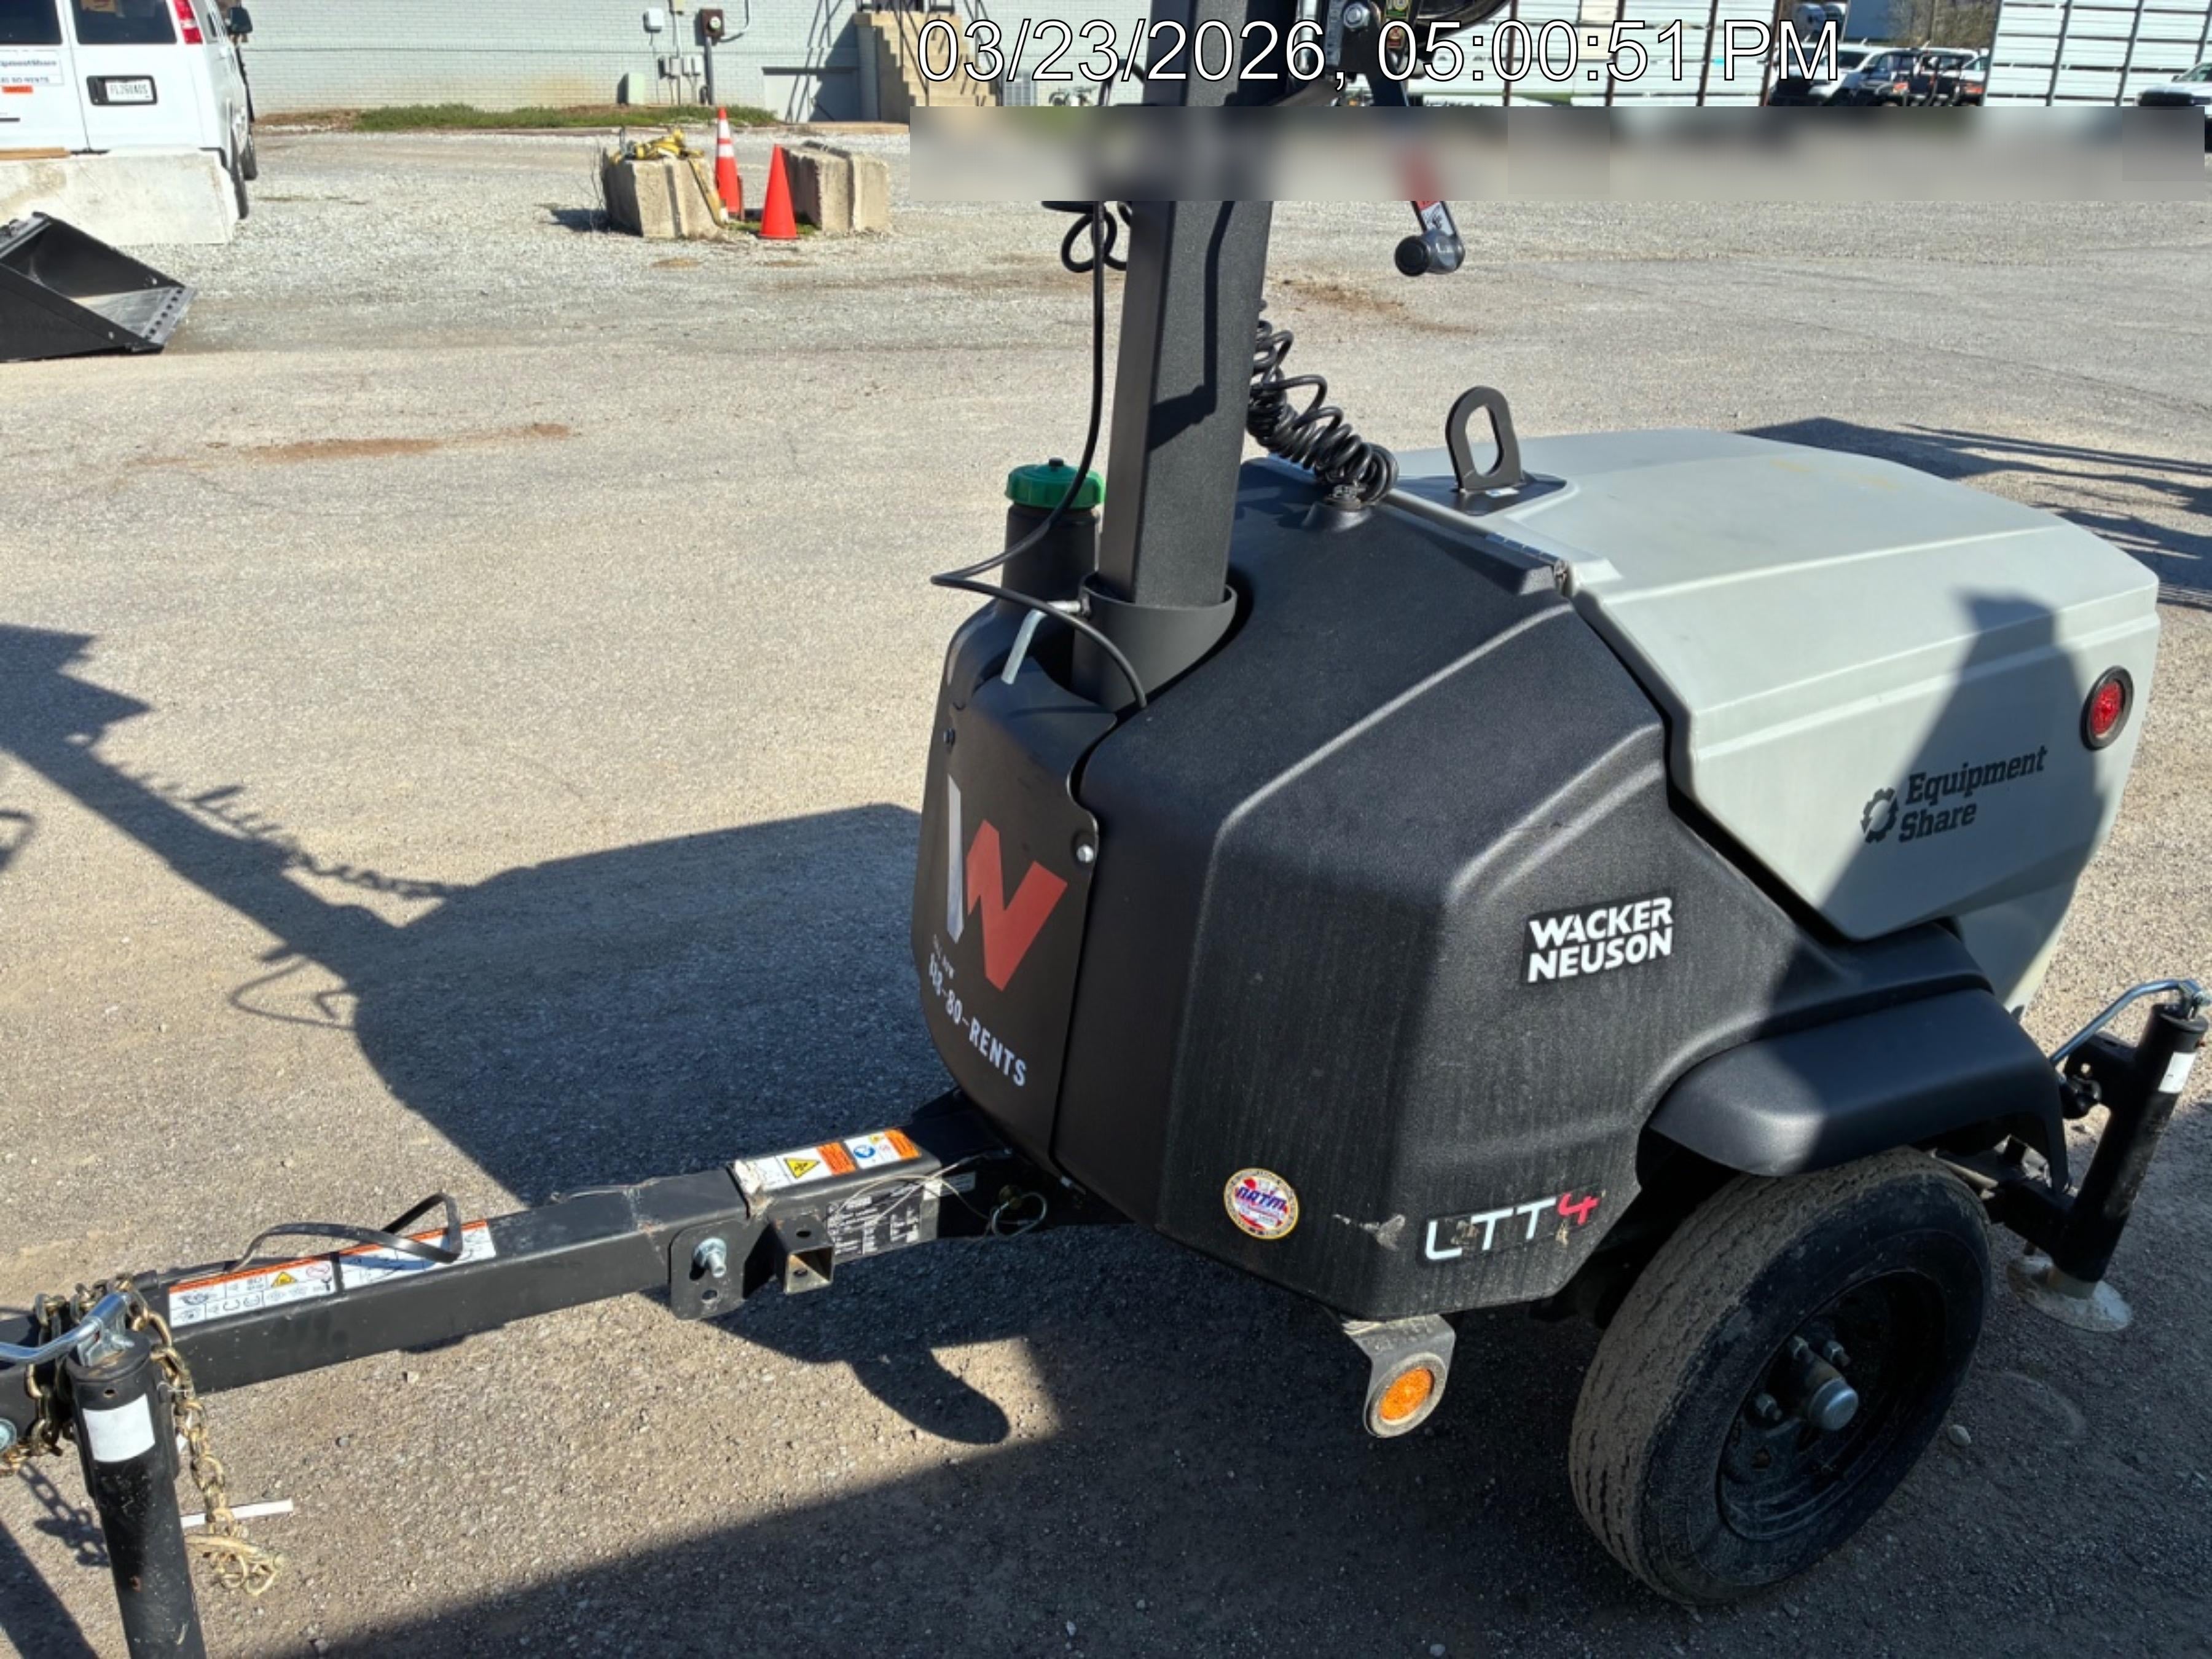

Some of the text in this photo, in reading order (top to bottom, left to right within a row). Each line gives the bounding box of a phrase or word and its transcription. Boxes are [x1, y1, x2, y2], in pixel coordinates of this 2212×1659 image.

[1905, 745, 2049, 806] Equipment
[1898, 803, 1977, 843] Share
[1529, 896, 1673, 950] WACKER
[1528, 926, 1673, 983] NEUSON
